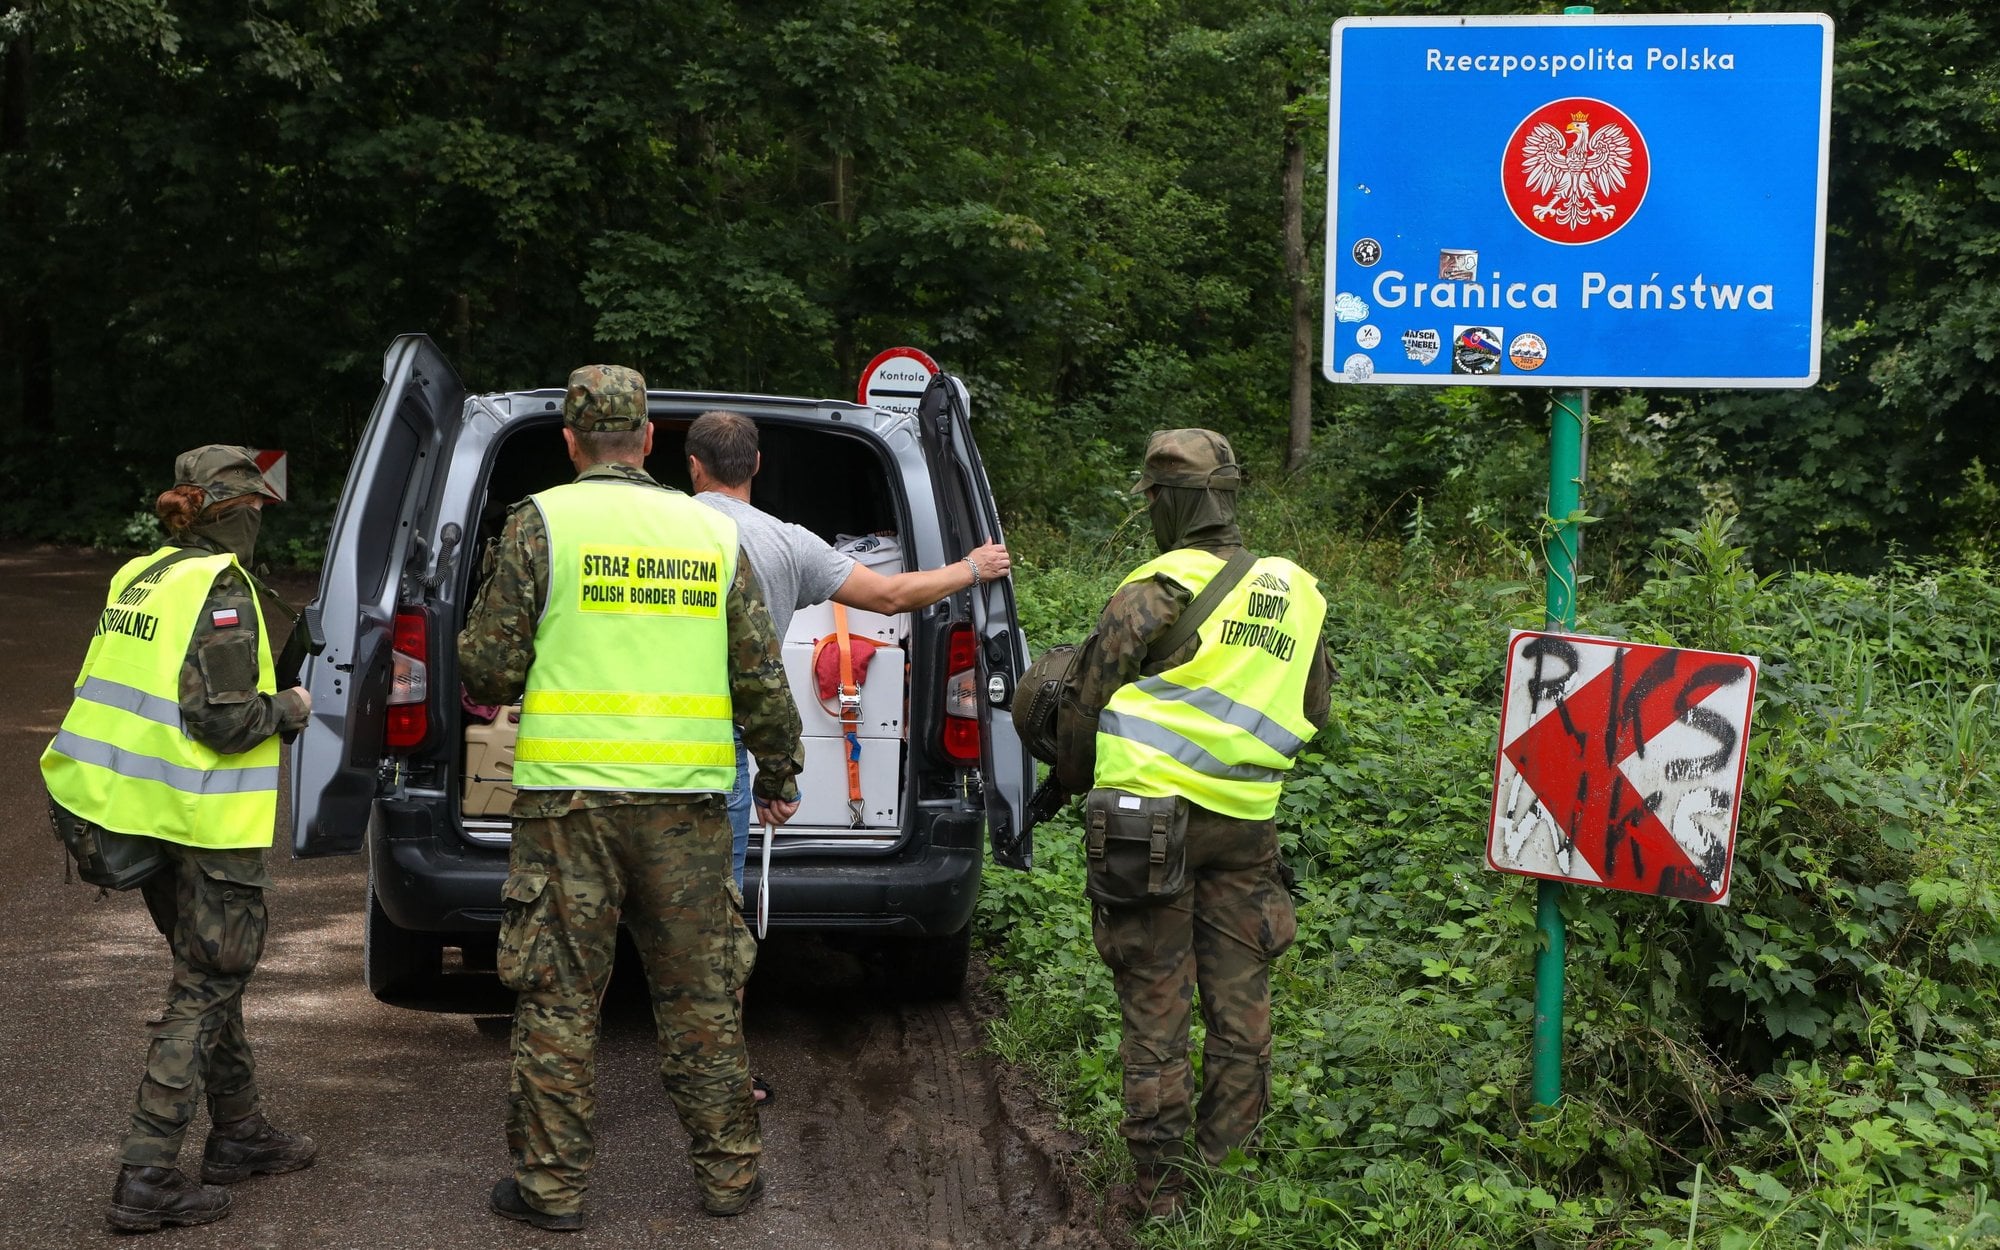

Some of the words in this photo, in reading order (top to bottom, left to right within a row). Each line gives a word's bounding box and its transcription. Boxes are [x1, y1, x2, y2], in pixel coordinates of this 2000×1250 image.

[1426, 48, 1634, 77] Rzeczpospolita
[1647, 48, 1735, 71] Polska
[1372, 271, 1558, 310] Granica
[1582, 273, 1774, 310] Państwa
[880, 370, 925, 382] Kontrola
[583, 554, 630, 577] STRAŻ
[636, 557, 718, 583] GRANICZNA
[582, 585, 625, 603] POLISH
[630, 588, 676, 605] BORDER
[682, 590, 717, 608] GUARD
[1247, 591, 1290, 623] OBRONY
